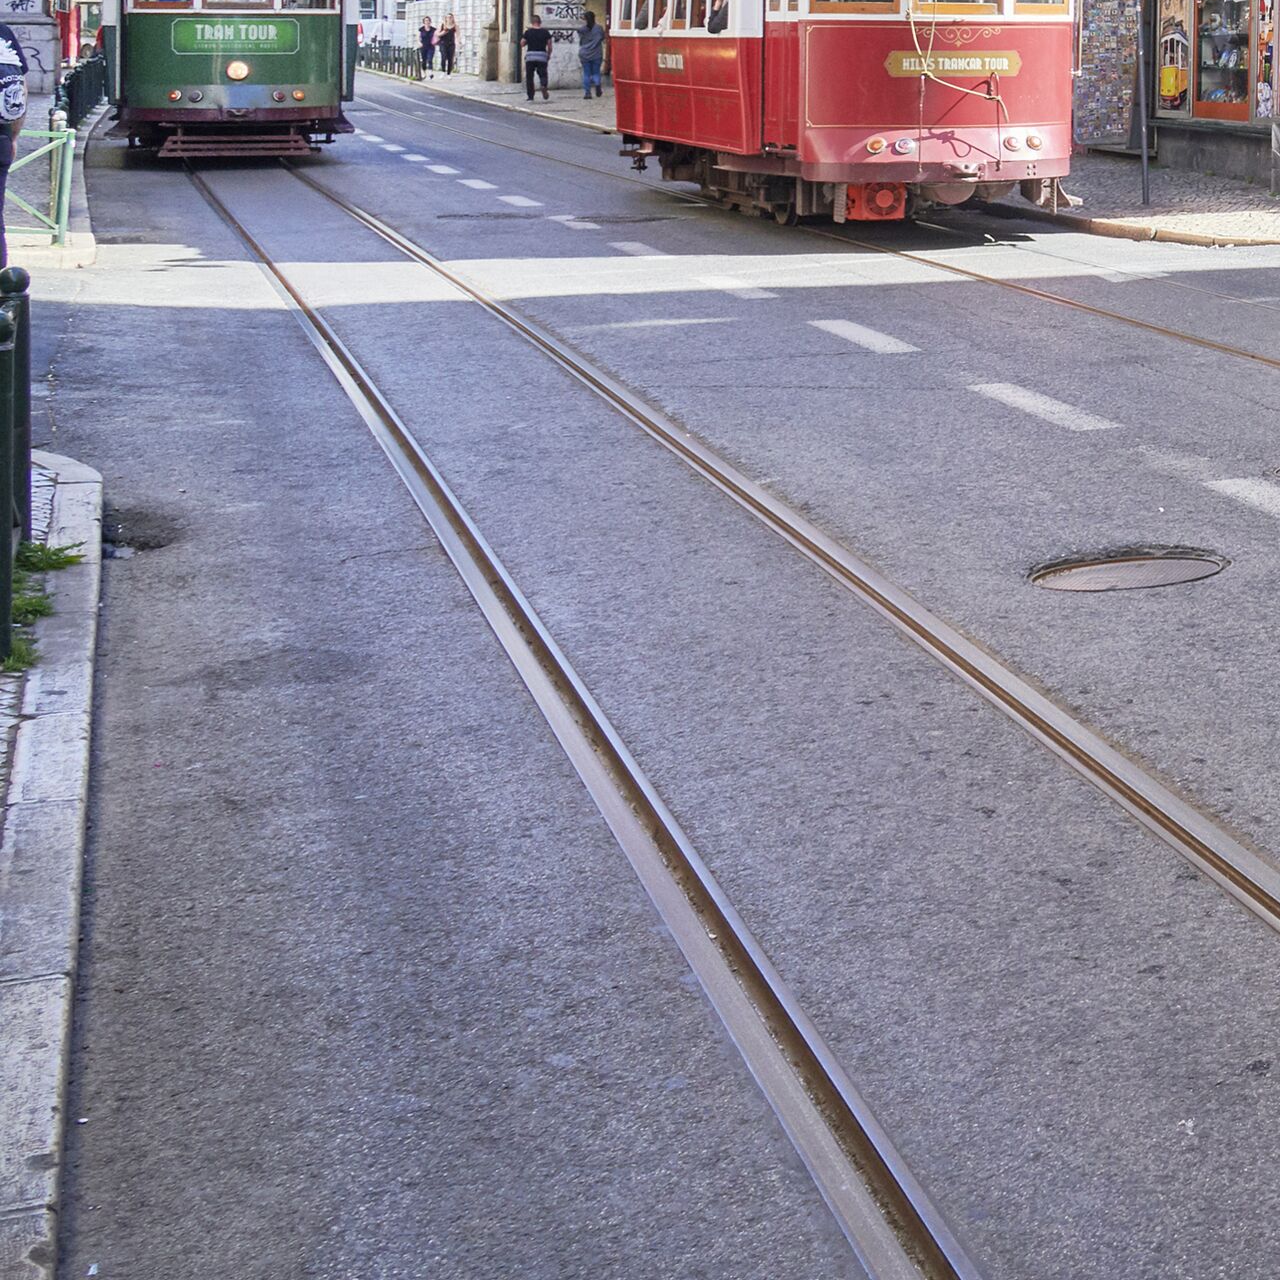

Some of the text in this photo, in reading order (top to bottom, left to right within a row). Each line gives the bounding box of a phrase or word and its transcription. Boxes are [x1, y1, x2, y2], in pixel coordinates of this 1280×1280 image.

[195, 24, 278, 40] TRAM TOUR
[938, 58, 982, 70] TRAMCAR
[985, 58, 1009, 70] TOUR
